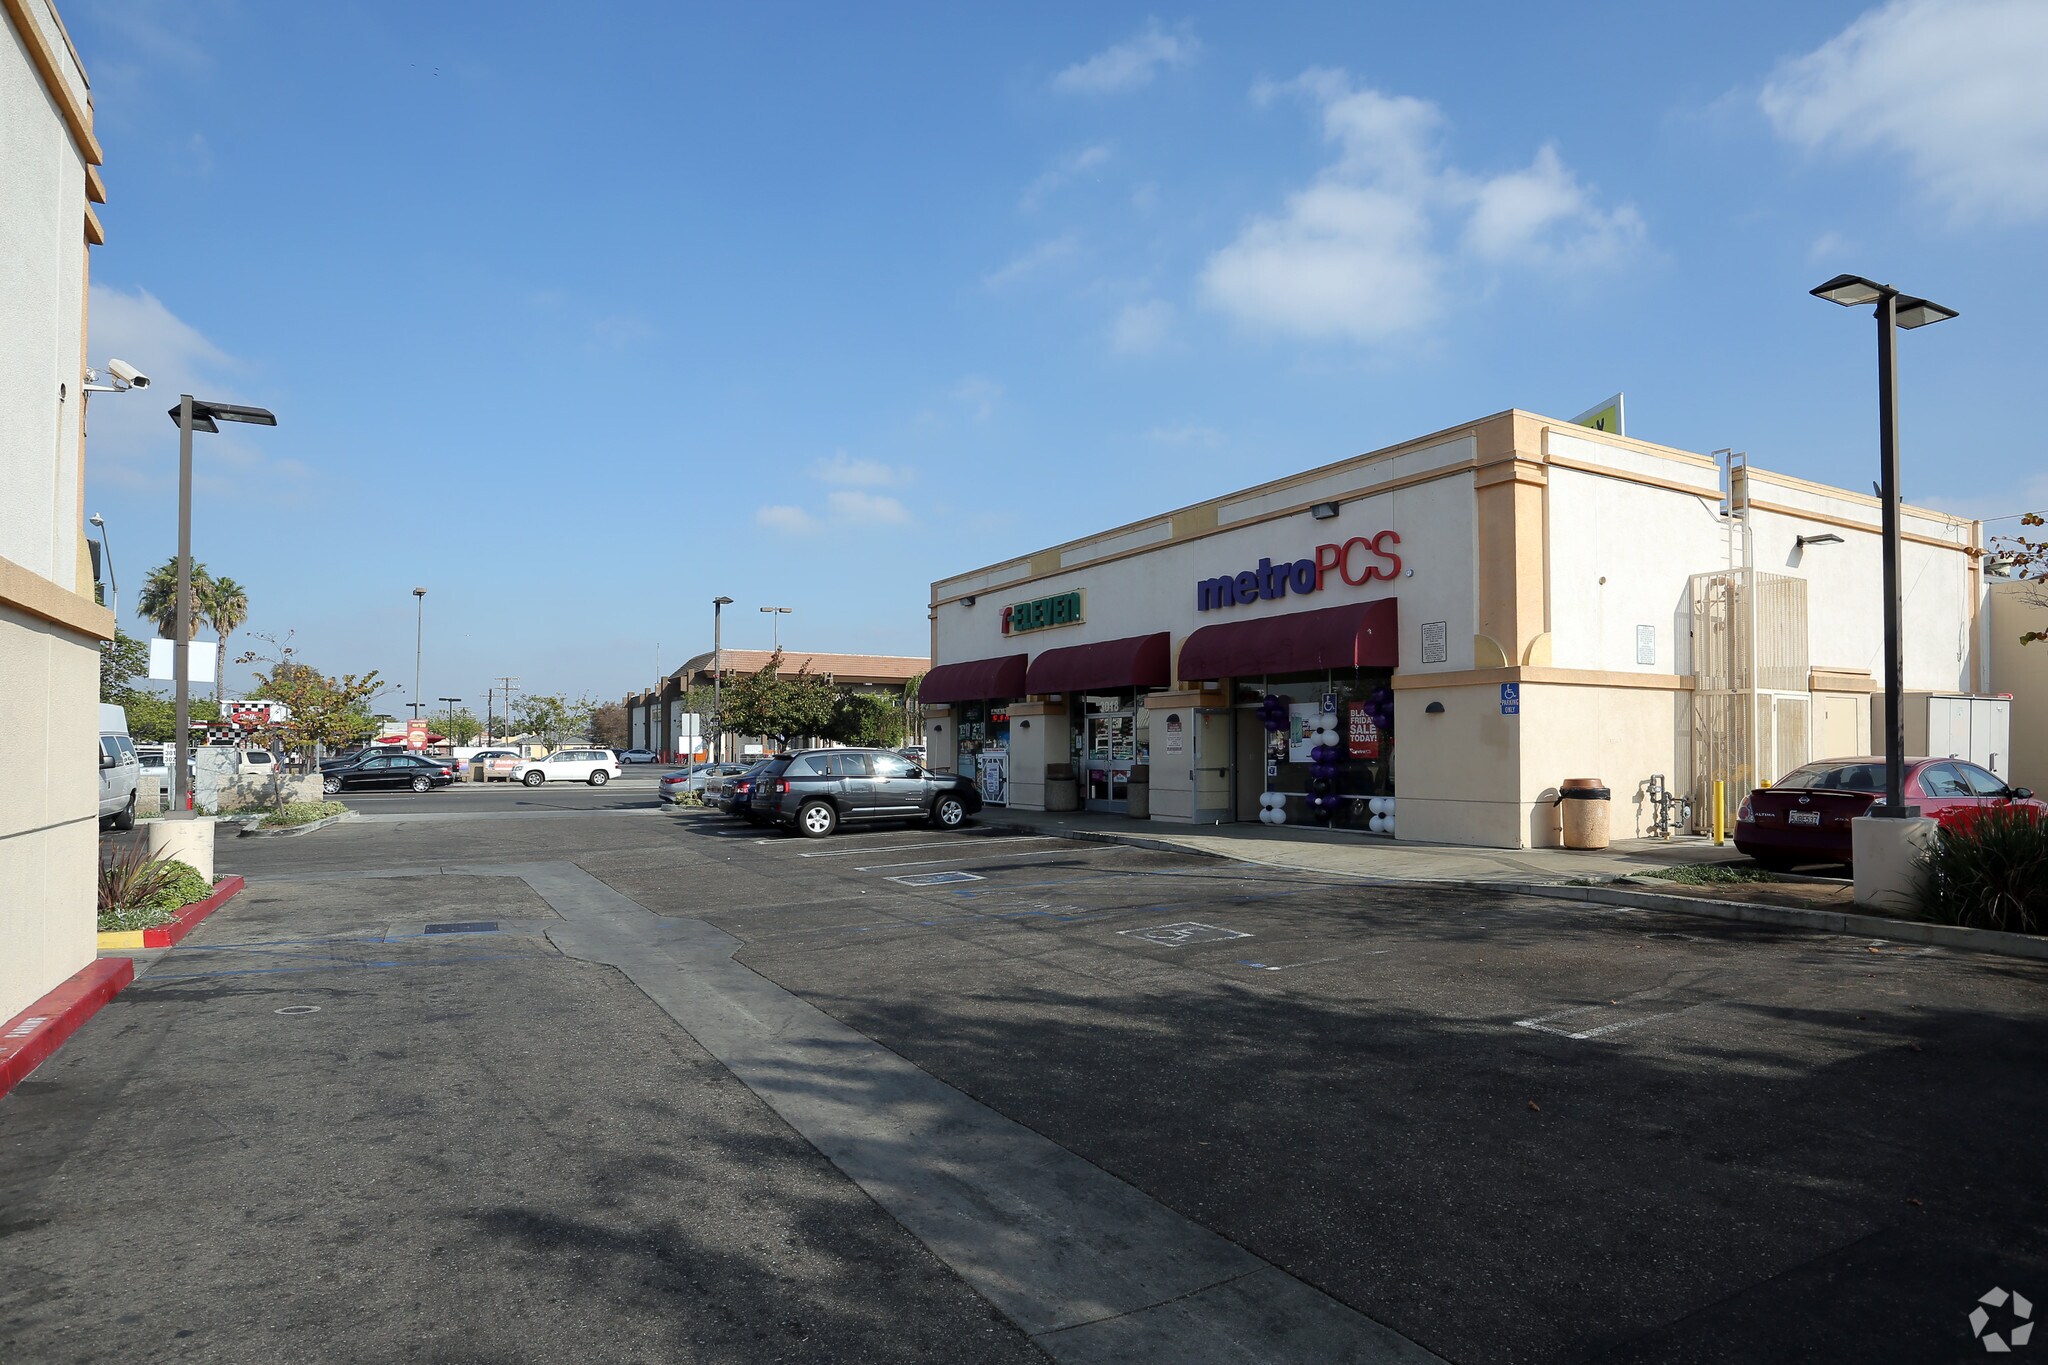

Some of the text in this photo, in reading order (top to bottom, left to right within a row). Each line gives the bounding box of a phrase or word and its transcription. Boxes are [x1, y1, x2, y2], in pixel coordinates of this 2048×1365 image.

[1198, 530, 1402, 611] metroPCS
[1100, 701, 1119, 712] 3018
[1350, 724, 1376, 734] SALE
